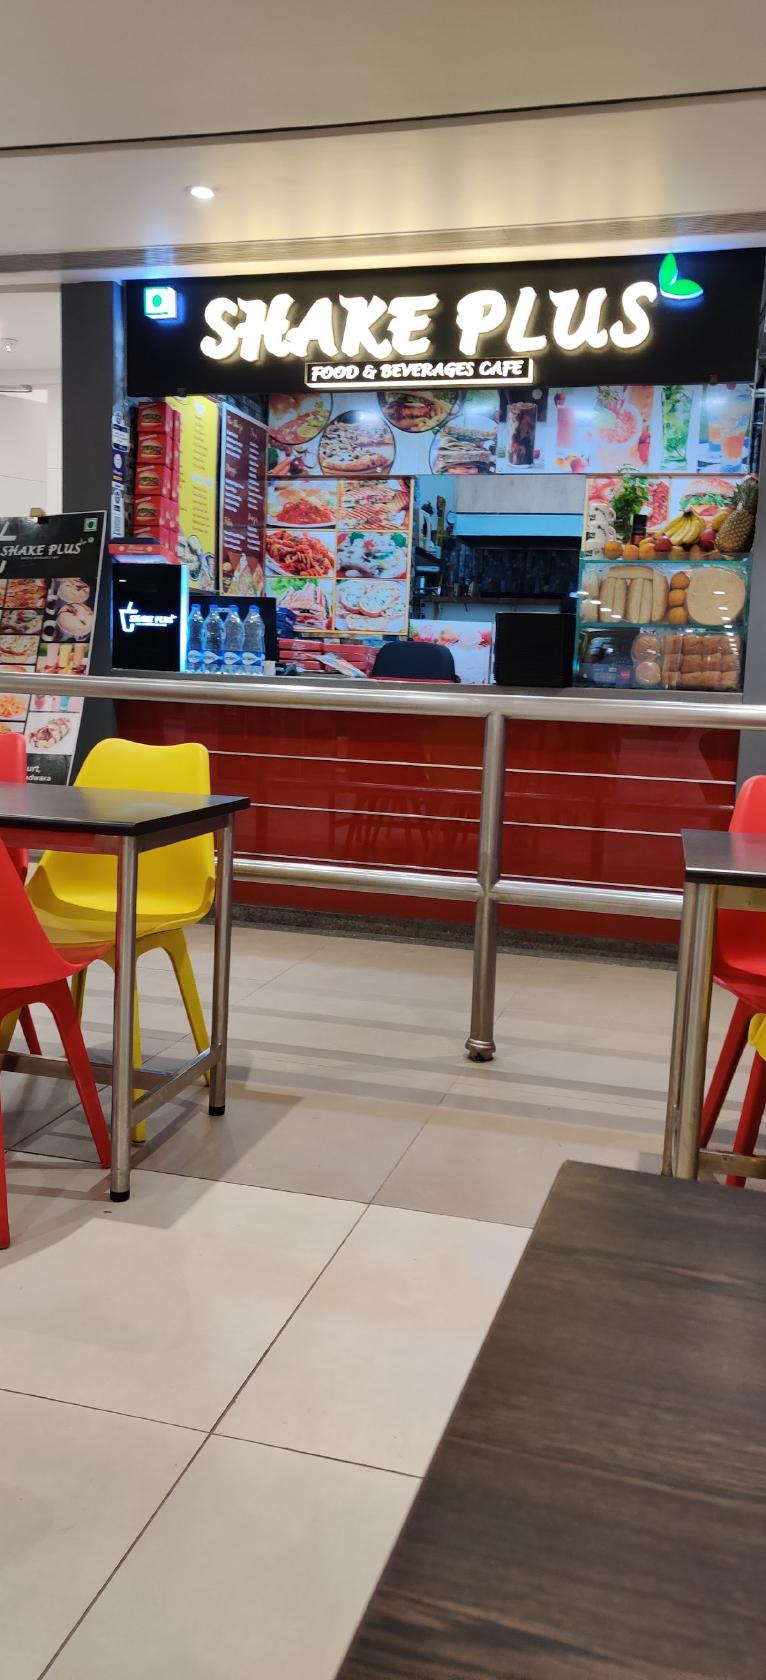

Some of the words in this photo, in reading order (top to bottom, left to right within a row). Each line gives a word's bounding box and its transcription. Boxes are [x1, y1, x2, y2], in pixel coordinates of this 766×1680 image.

[200, 294, 439, 361] SHAKE
[456, 282, 657, 354] PLUS
[311, 365, 360, 382] FOOD
[362, 365, 378, 380] &
[379, 362, 475, 379] BEVERAGES
[478, 360, 525, 377] CAFE
[0, 544, 46, 556] SHAKE
[48, 543, 81, 555] PLUS
[27, 765, 41, 773] urt,
